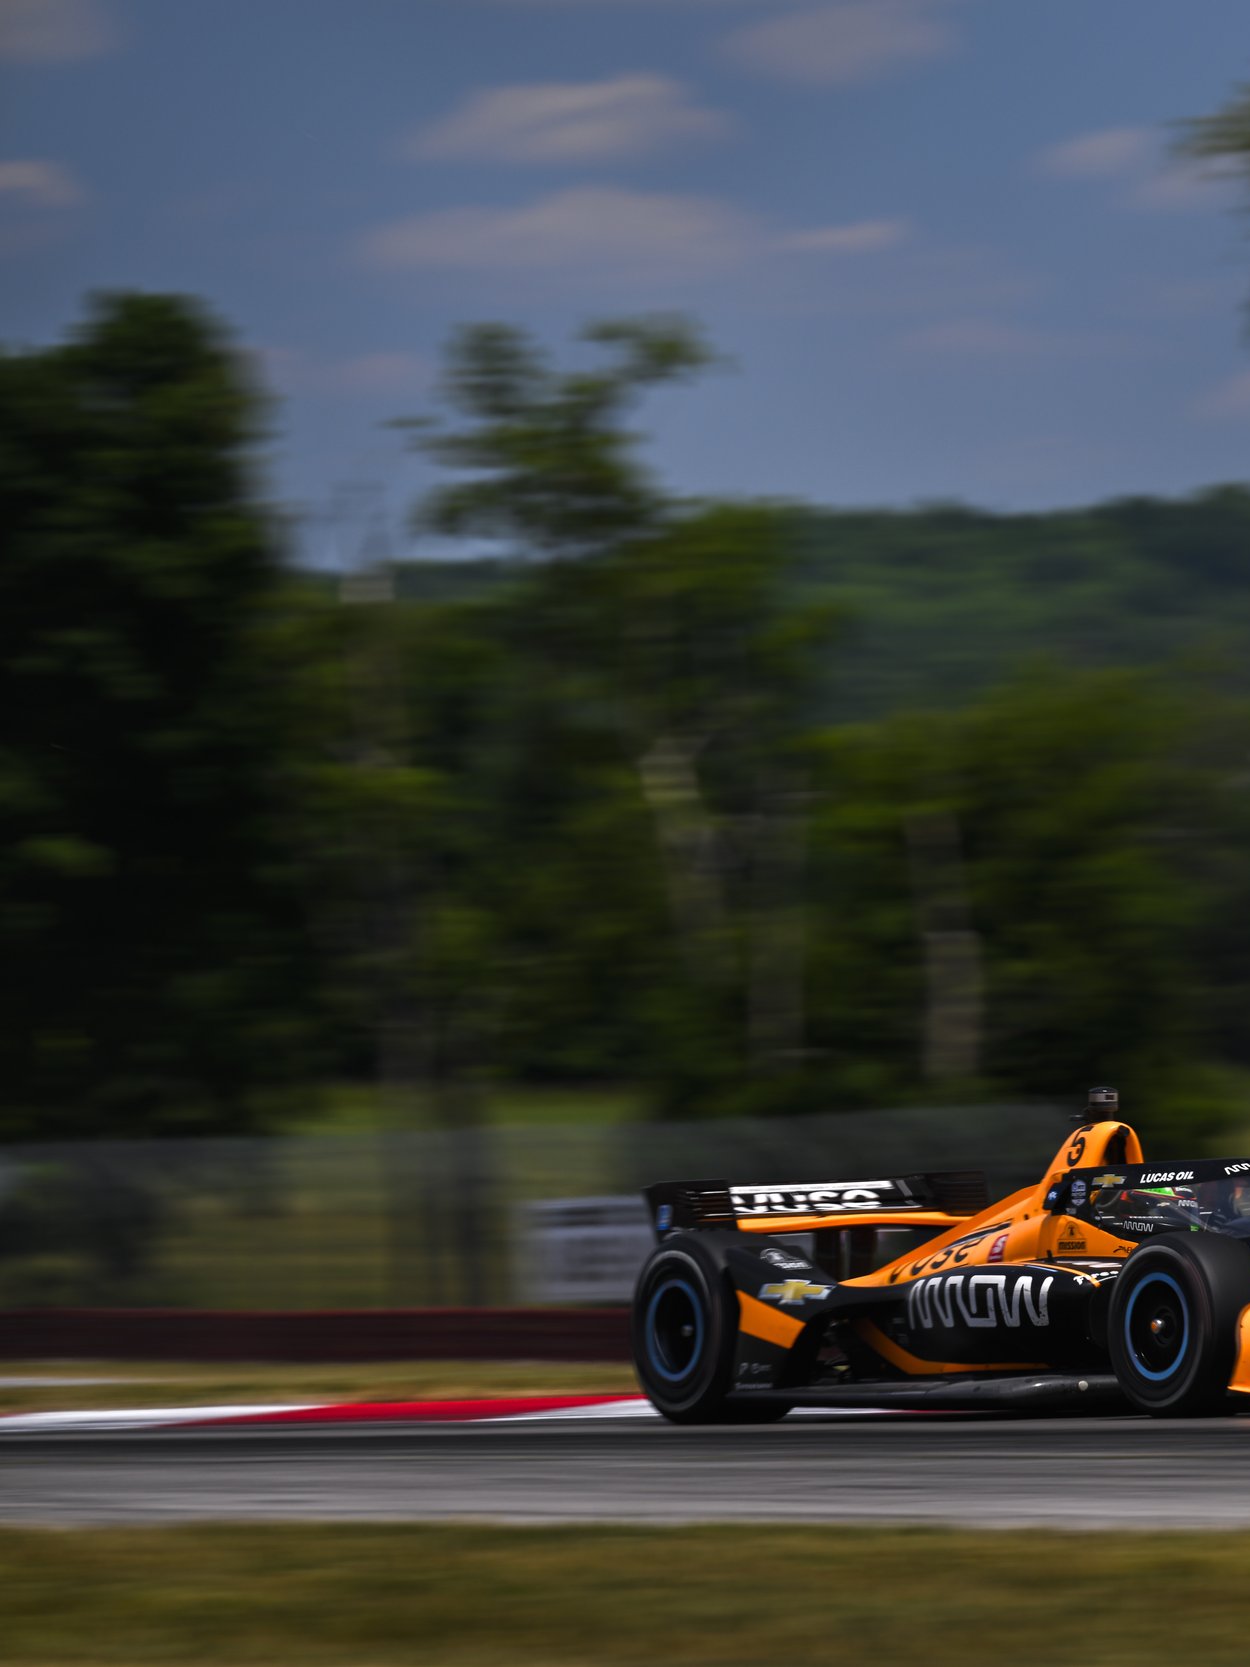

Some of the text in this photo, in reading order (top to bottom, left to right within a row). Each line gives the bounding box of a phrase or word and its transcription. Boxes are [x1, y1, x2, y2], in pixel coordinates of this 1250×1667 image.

[1066, 1125, 1094, 1167] 5
[1140, 1170, 1194, 1184] LUCAS OIL
[1123, 1220, 1154, 1232] ARROW
[908, 1274, 1055, 1329] ARROW
